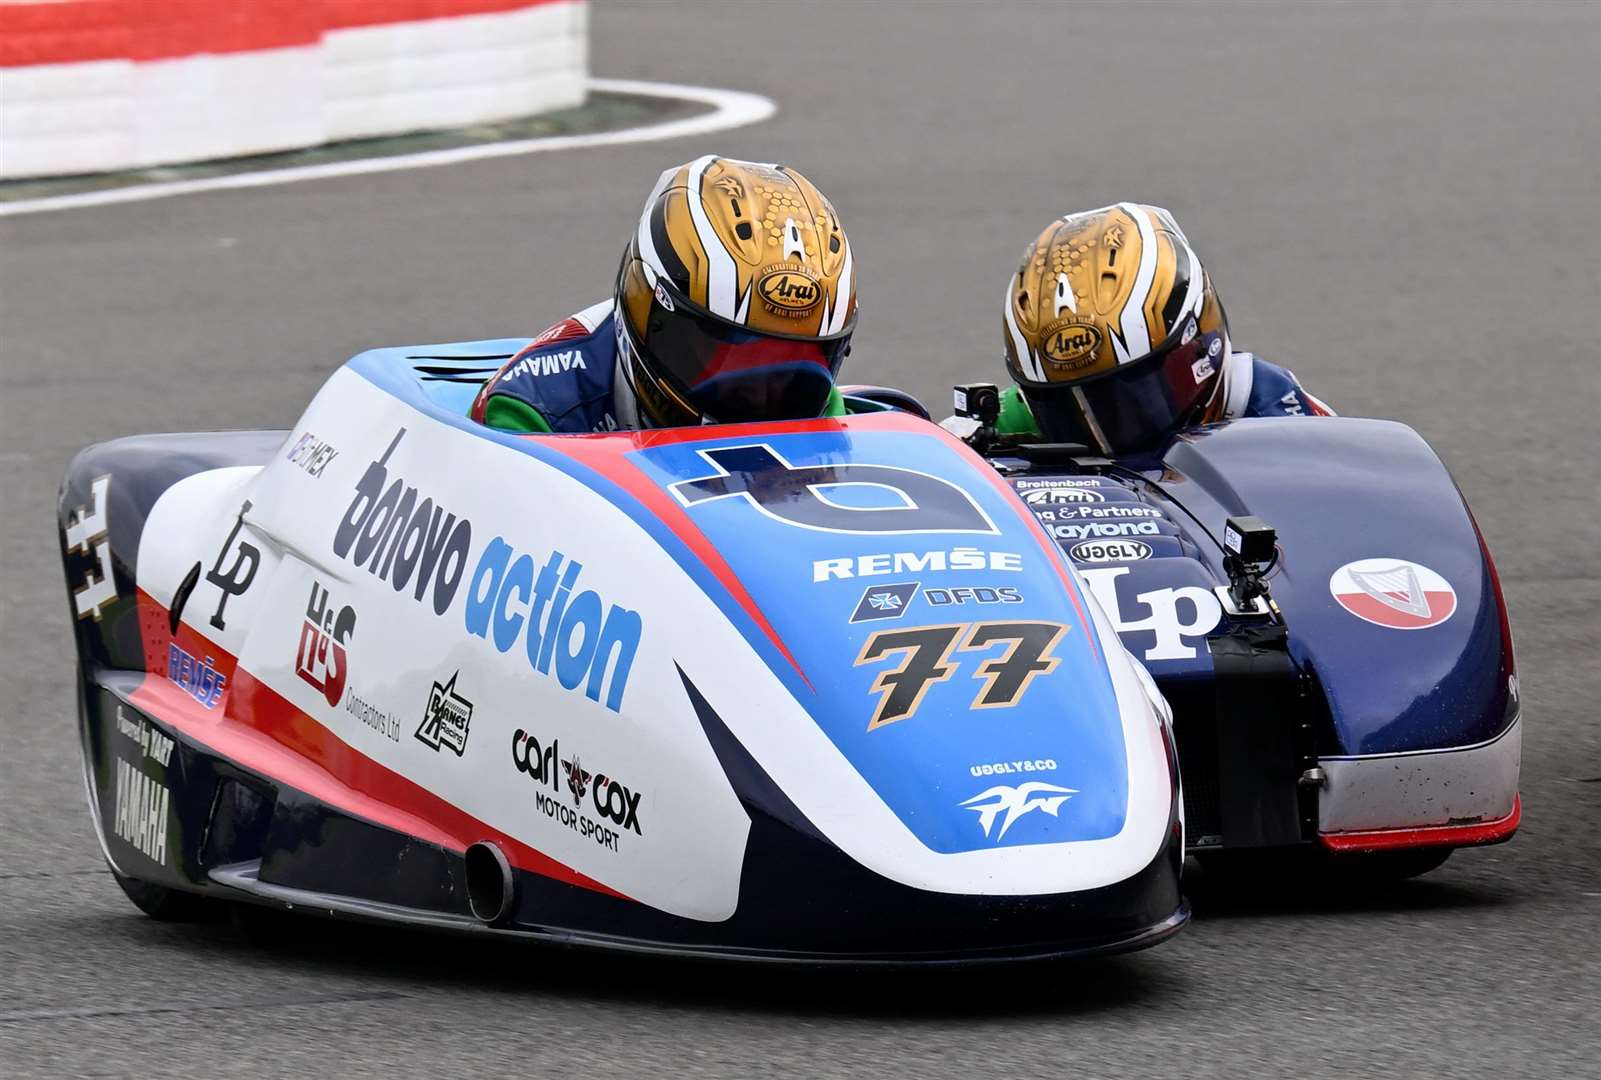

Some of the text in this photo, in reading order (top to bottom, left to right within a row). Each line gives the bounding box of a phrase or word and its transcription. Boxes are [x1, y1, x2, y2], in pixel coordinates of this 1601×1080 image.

[763, 275, 814, 300] Arai
[1047, 328, 1092, 356] Arai
[1016, 480, 1101, 489] Breitenbach
[333, 426, 471, 616] bonovo
[1059, 506, 1078, 519] &
[1078, 506, 1162, 518] Partners
[922, 587, 1024, 606] DFDS
[465, 536, 643, 714] action
[853, 619, 1072, 733] 77
[345, 686, 401, 743] Contractors Ltd
[440, 721, 465, 746] Racing
[114, 756, 170, 867] YAMAHA
[536, 790, 620, 853] MOTOR SPORT
